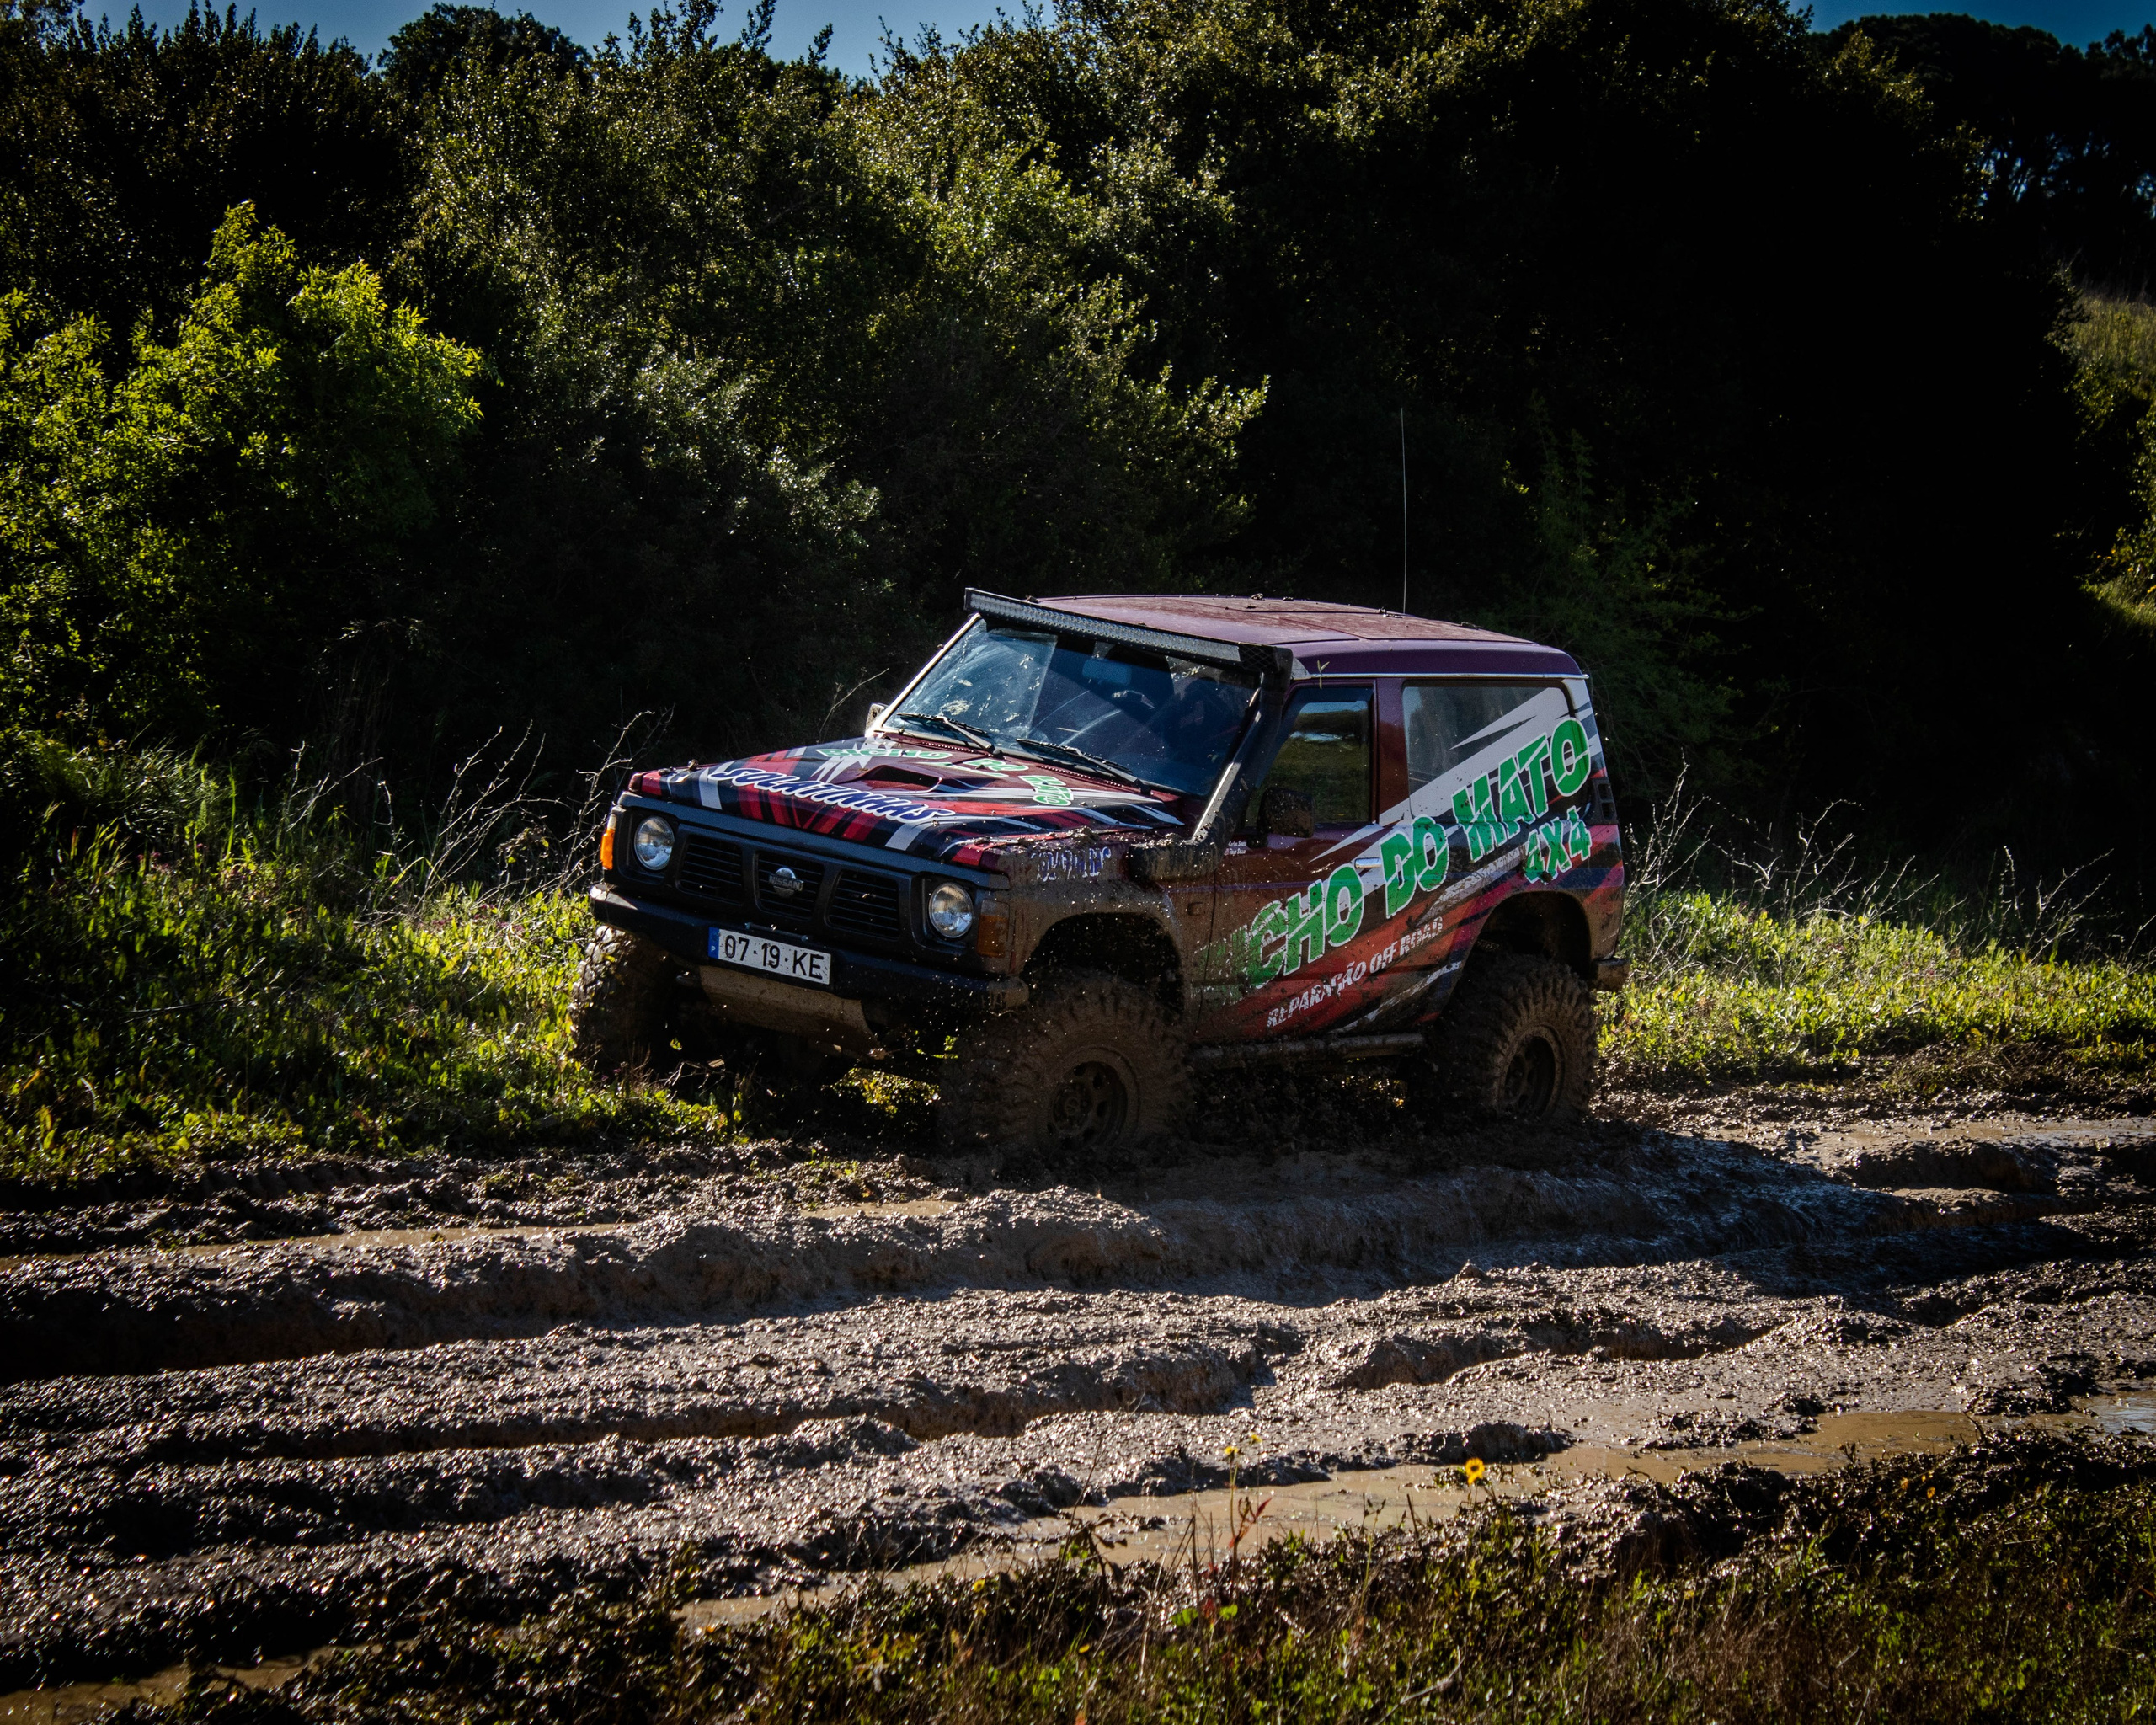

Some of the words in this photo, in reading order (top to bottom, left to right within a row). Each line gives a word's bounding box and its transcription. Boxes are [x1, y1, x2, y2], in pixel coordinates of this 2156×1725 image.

[707, 767, 956, 824] SOLATINHAS
[1380, 814, 1449, 919] DO
[1451, 717, 1592, 862] MATO
[1524, 805, 1593, 884] 4X4
[768, 873, 804, 892] NISSAN
[1369, 940, 1397, 974] OFF
